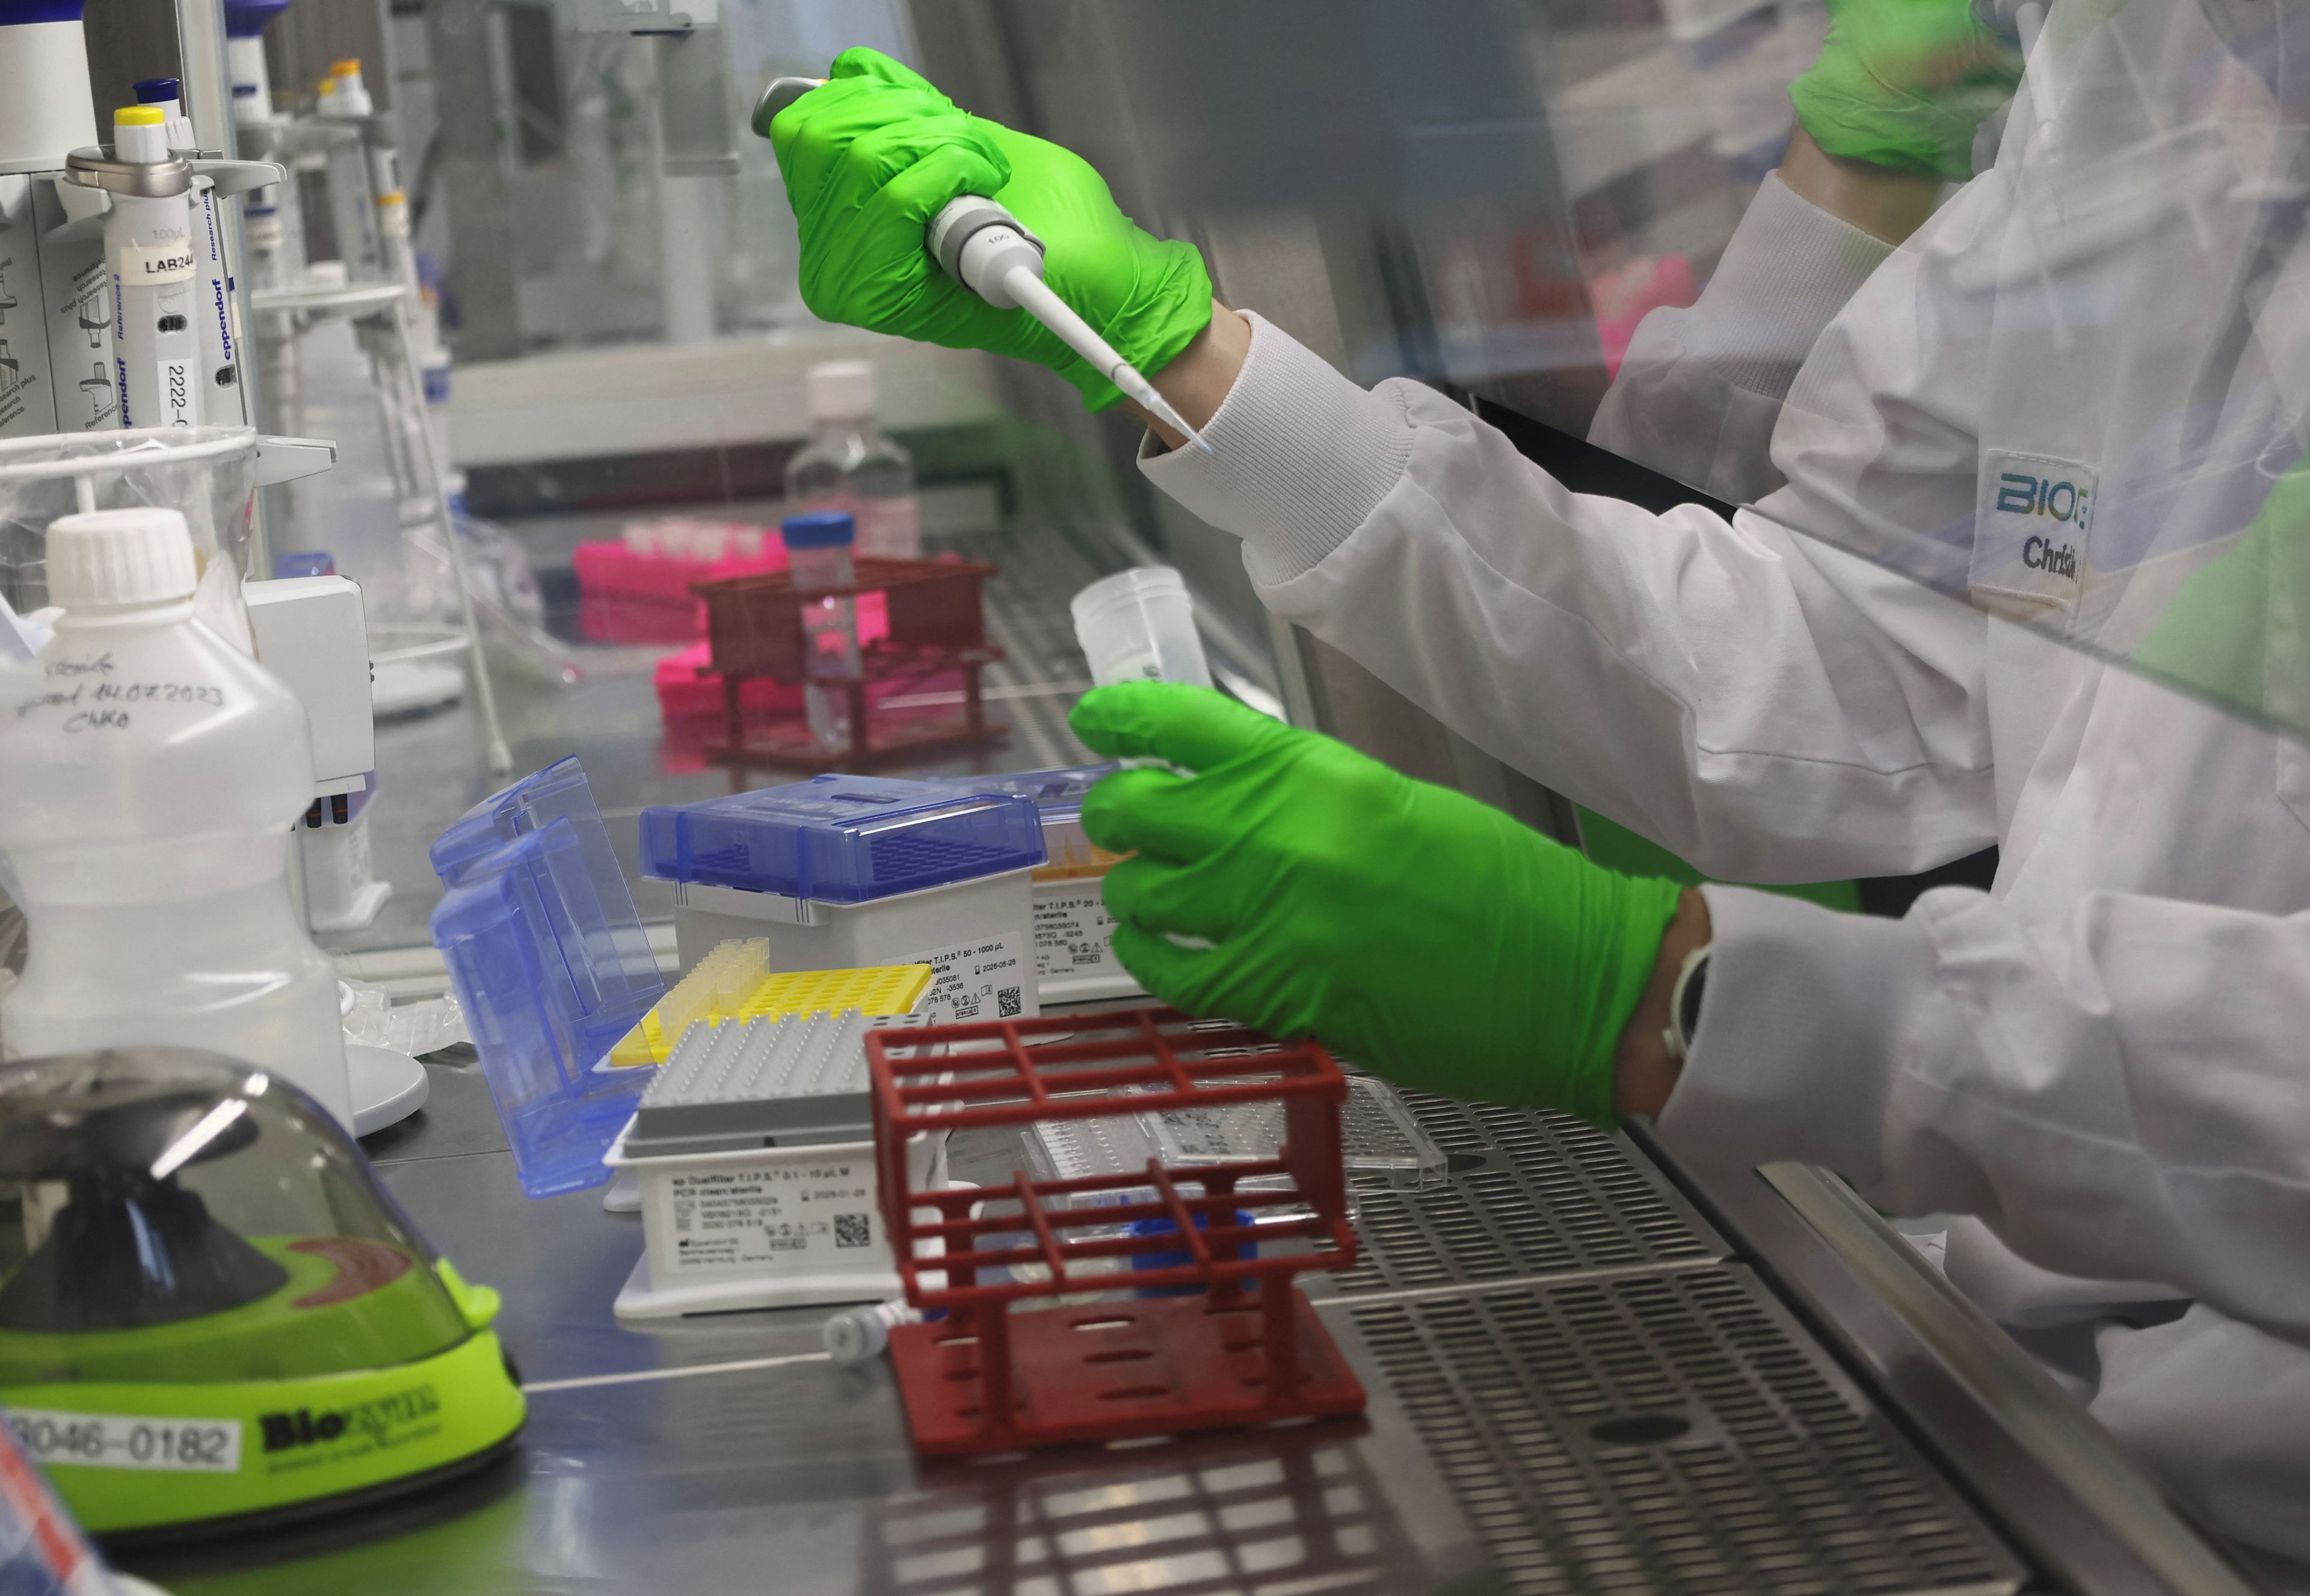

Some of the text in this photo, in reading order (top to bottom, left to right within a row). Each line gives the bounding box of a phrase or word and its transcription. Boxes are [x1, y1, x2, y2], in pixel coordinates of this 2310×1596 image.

[206, 214, 217, 260] Research
[212, 279, 232, 360] eppendorf
[963, 949, 972, 958] 50
[978, 944, 993, 954] 1000
[994, 942, 1004, 952] µL
[939, 993, 951, 1003] 578
